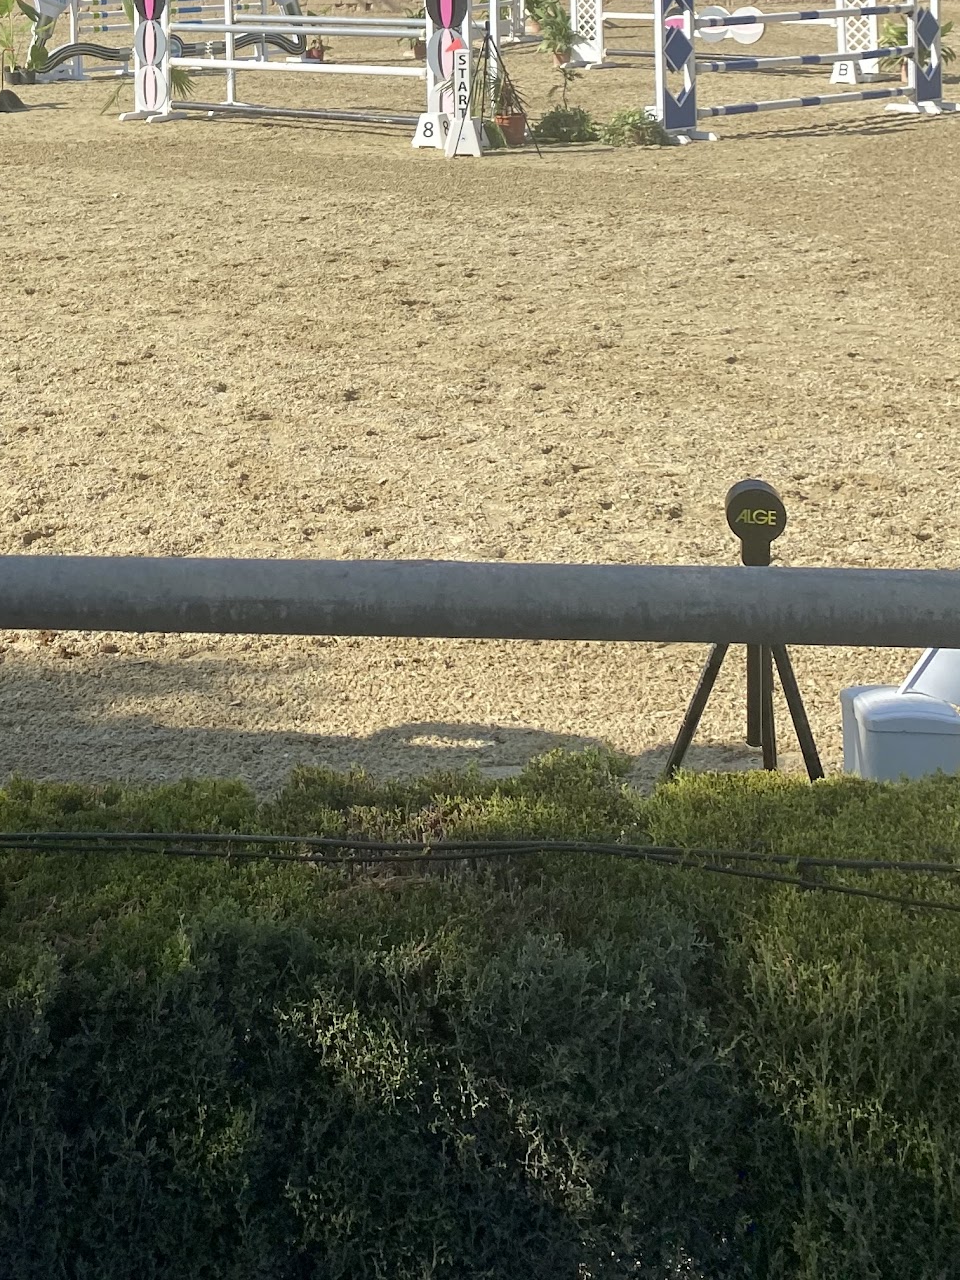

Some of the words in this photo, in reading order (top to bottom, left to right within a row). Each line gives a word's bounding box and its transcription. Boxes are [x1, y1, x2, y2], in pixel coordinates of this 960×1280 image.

[458, 54, 468, 118] START
[423, 121, 434, 138] 8
[735, 508, 777, 526] ALGE
